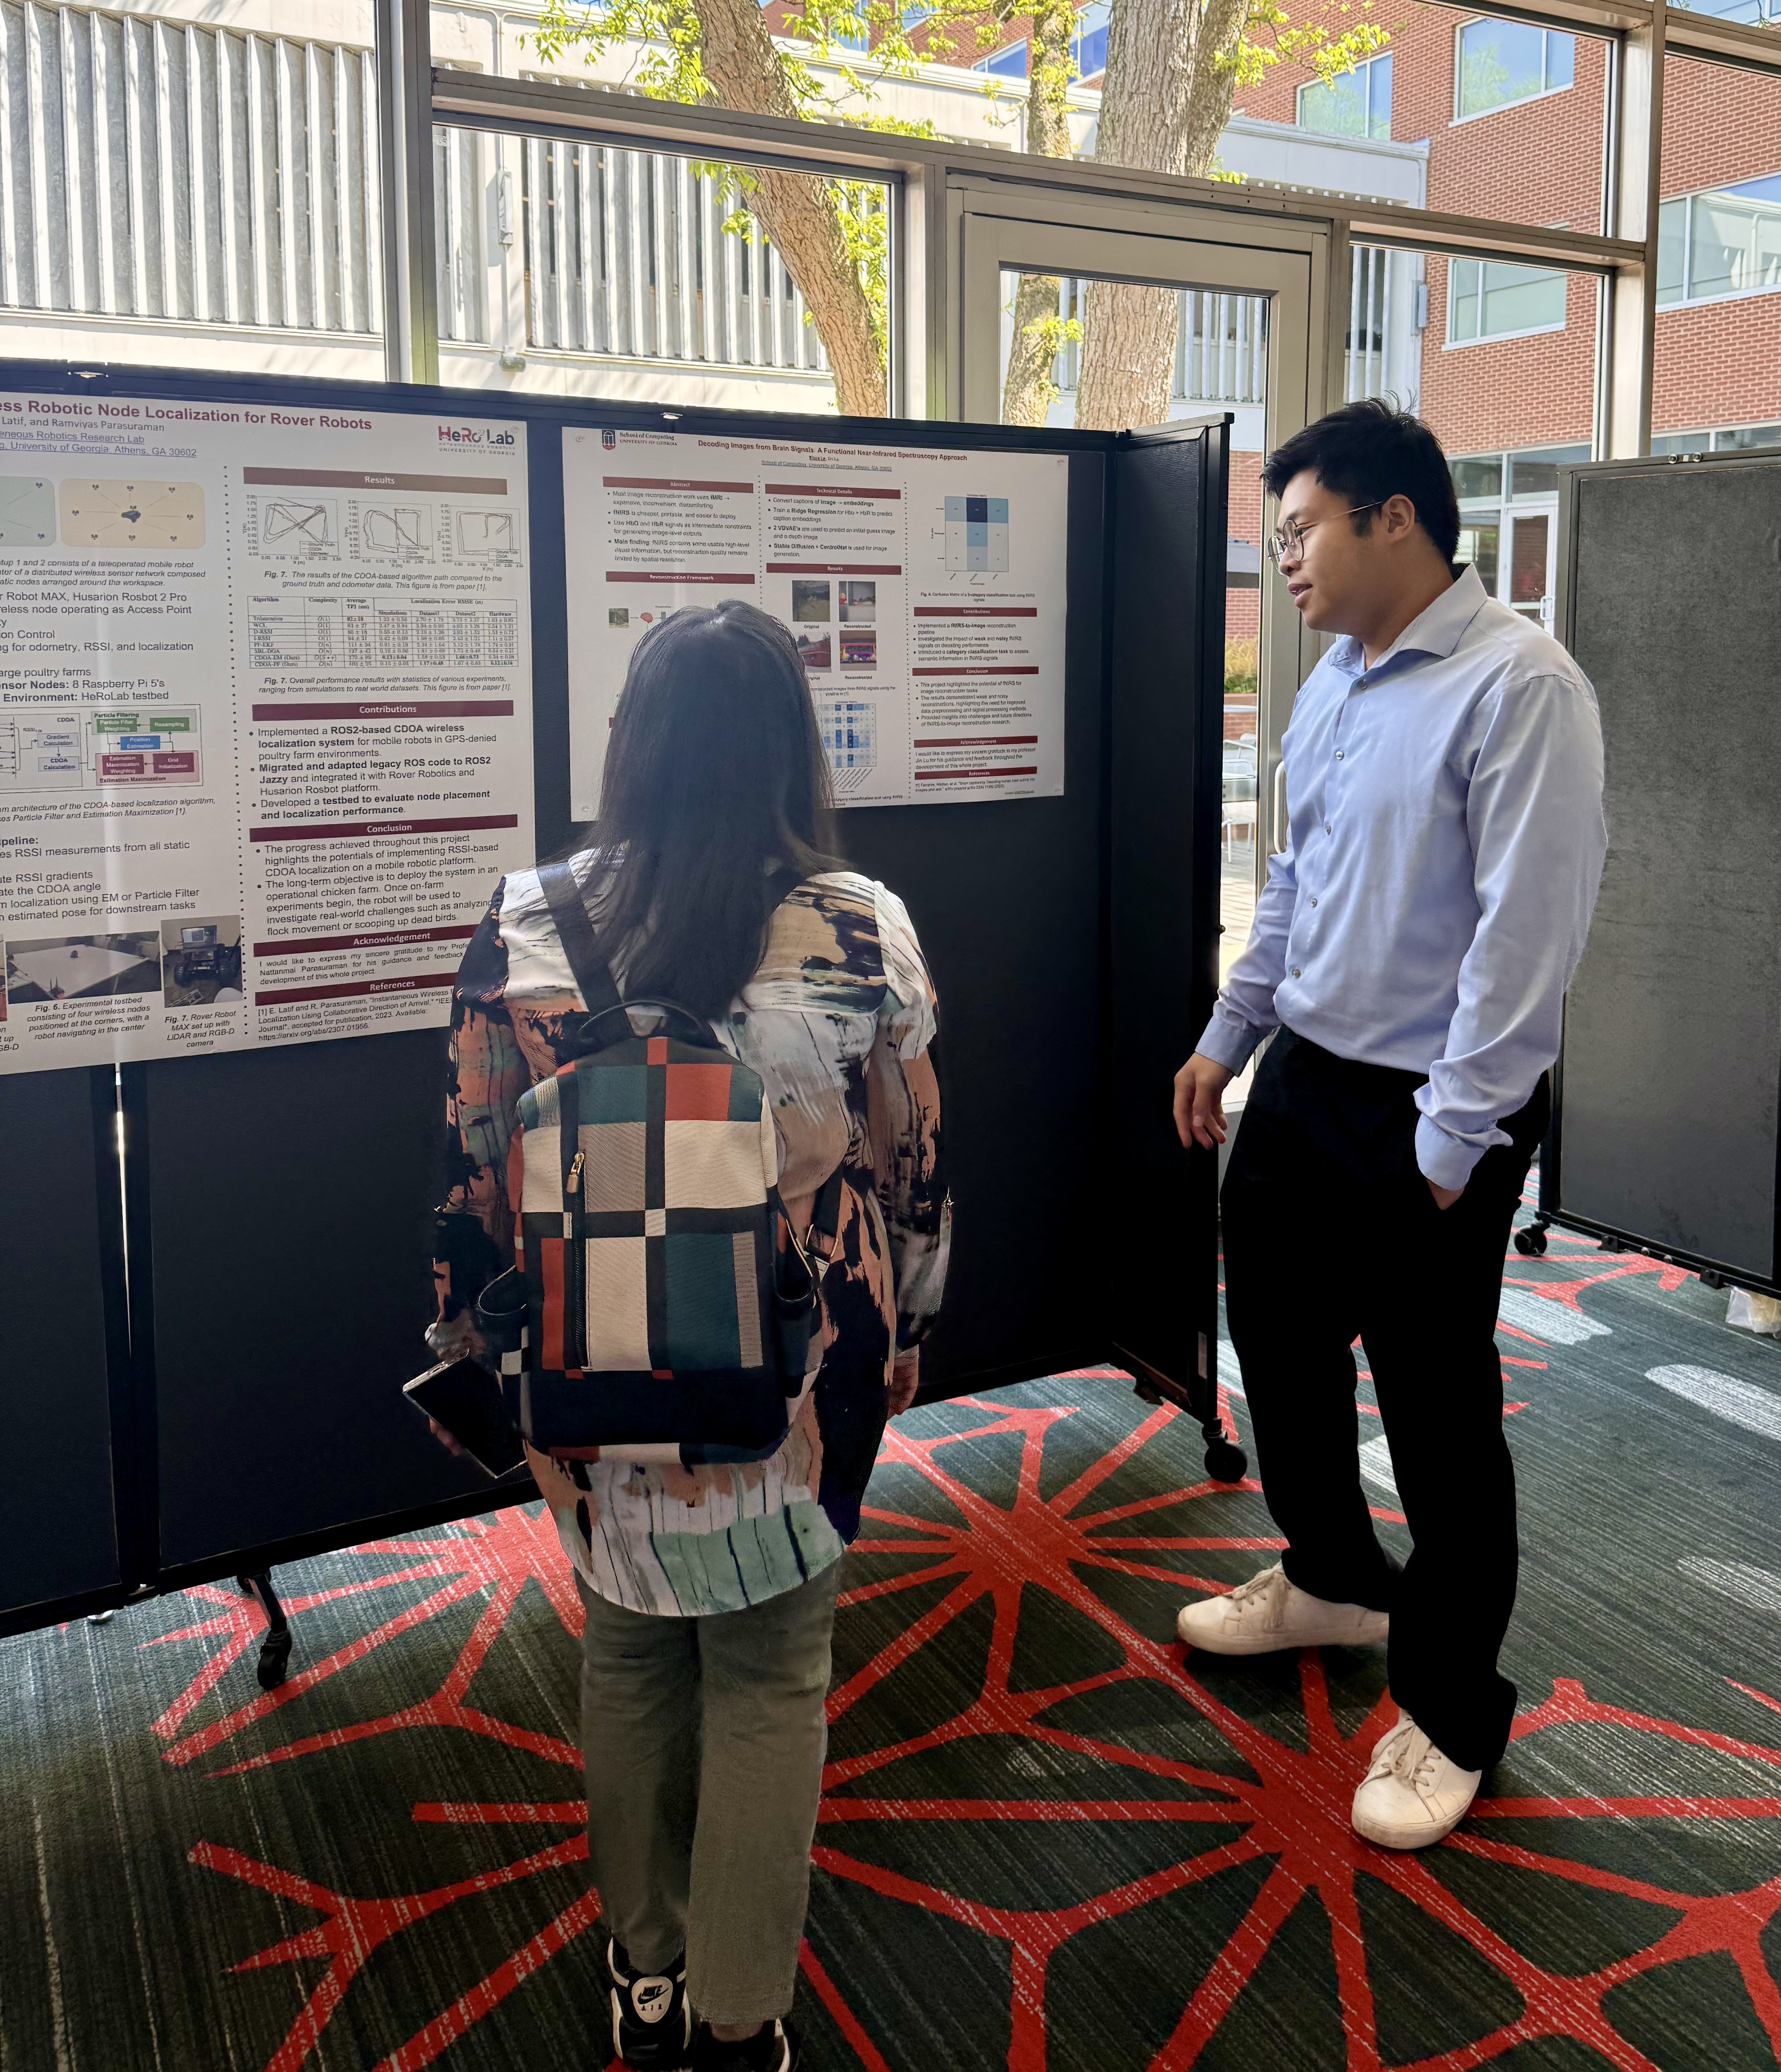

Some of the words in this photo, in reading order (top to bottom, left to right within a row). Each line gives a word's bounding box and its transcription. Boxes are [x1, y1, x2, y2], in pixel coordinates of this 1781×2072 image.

[28, 400, 92, 415] Robotic
[98, 404, 139, 417] Node
[145, 406, 239, 422] Localization
[244, 411, 266, 423] for
[271, 412, 315, 426] Rover
[320, 415, 372, 429] Robots
[2, 416, 26, 426] Latif,
[30, 418, 49, 426] and
[52, 418, 98, 429] Ramviyas
[101, 420, 164, 431] Parasuraman
[36, 431, 77, 441] Robotics
[80, 433, 124, 442] Research
[487, 429, 514, 445] Lab
[10, 441, 57, 451] University
[60, 444, 69, 452] of
[169, 448, 196, 456] 30602
[698, 440, 729, 449] Decoding
[898, 452, 937, 460] Spectroscopy
[365, 476, 395, 484] Results
[6, 592, 38, 600] Robot
[41, 592, 69, 602] MAX,
[73, 592, 118, 601] Husarion
[122, 592, 157, 601] Rosbot
[160, 593, 166, 601] 2
[169, 593, 187, 601] Pro
[32, 605, 58, 613] node
[61, 605, 109, 615] operating
[127, 605, 163, 613] Access
[167, 605, 192, 613] Point
[11, 642, 26, 651] for
[29, 642, 80, 653] odometry,
[84, 642, 113, 652] RSSI,
[116, 642, 135, 651] and
[138, 642, 193, 651] localization
[24, 668, 59, 678] poultry
[62, 667, 91, 676] farms
[30, 680, 69, 689] Nodes:
[73, 680, 79, 688] 8
[82, 680, 134, 690] Raspberry
[138, 679, 147, 687] Pi
[151, 679, 164, 687] 5's
[3, 693, 77, 702] Environment:
[81, 691, 129, 700] HeRoLab
[132, 691, 168, 700] testbed
[359, 705, 416, 713] Contributions
[258, 727, 319, 737] Implemented
[331, 725, 391, 734] ROS2-based
[426, 724, 464, 732] wireless
[258, 739, 315, 748] localization
[319, 739, 354, 748] system
[372, 736, 401, 745] mobile
[445, 734, 496, 743] GPS-denied
[259, 751, 291, 762] poultry
[259, 762, 303, 773] Migrated
[306, 762, 324, 770] and
[328, 760, 367, 770] adapted
[370, 760, 401, 770] legacy
[404, 759, 425, 767] ROS
[465, 756, 490, 765] ROS2
[261, 798, 311, 808] Developed
[322, 795, 359, 804] testbed
[374, 794, 414, 802] evaluate
[417, 792, 440, 800] node
[443, 790, 490, 801] placement
[367, 824, 412, 833] Conclusion
[264, 845, 282, 853] The
[286, 844, 326, 853] progress
[329, 839, 370, 849] achieved
[373, 837, 420, 847] throughout
[440, 834, 469, 844] project
[8, 909, 58, 921] estimated
[62, 909, 86, 918] pose
[89, 907, 103, 915] for
[106, 904, 167, 914] downstream
[170, 901, 195, 910] tasks
[267, 927, 289, 935] flock
[292, 923, 340, 933] movement
[355, 918, 395, 928] scooping
[411, 914, 432, 923] dead
[353, 932, 430, 945] Acknowledgement
[370, 981, 415, 991] References
[63, 999, 113, 1010] Experimental
[114, 996, 142, 1005] testbed
[641, 1984, 663, 1997] NIKE
